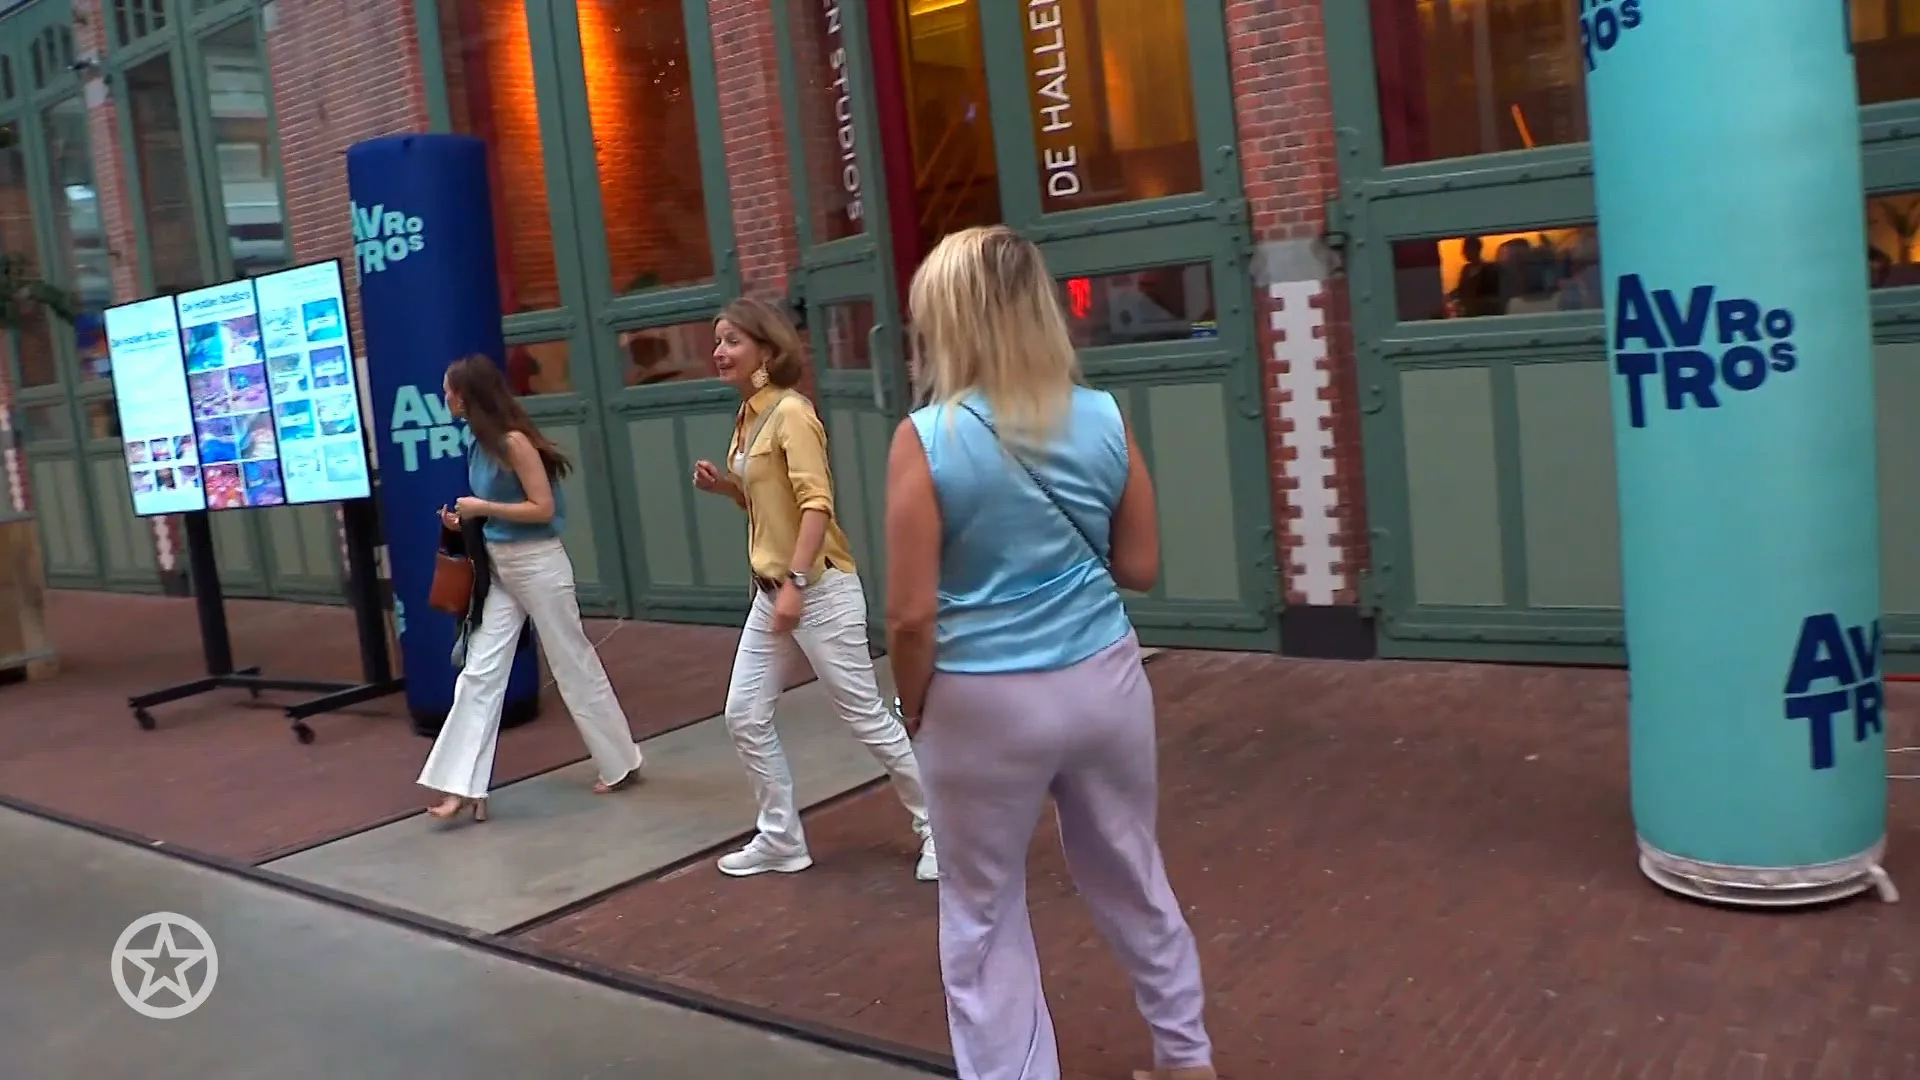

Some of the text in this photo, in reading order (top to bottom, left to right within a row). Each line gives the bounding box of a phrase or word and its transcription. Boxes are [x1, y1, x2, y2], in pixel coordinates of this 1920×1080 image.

[1029, 0, 1081, 196] DE HALLE
[1616, 273, 1794, 350] AVRO
[1616, 342, 1797, 428] TROS
